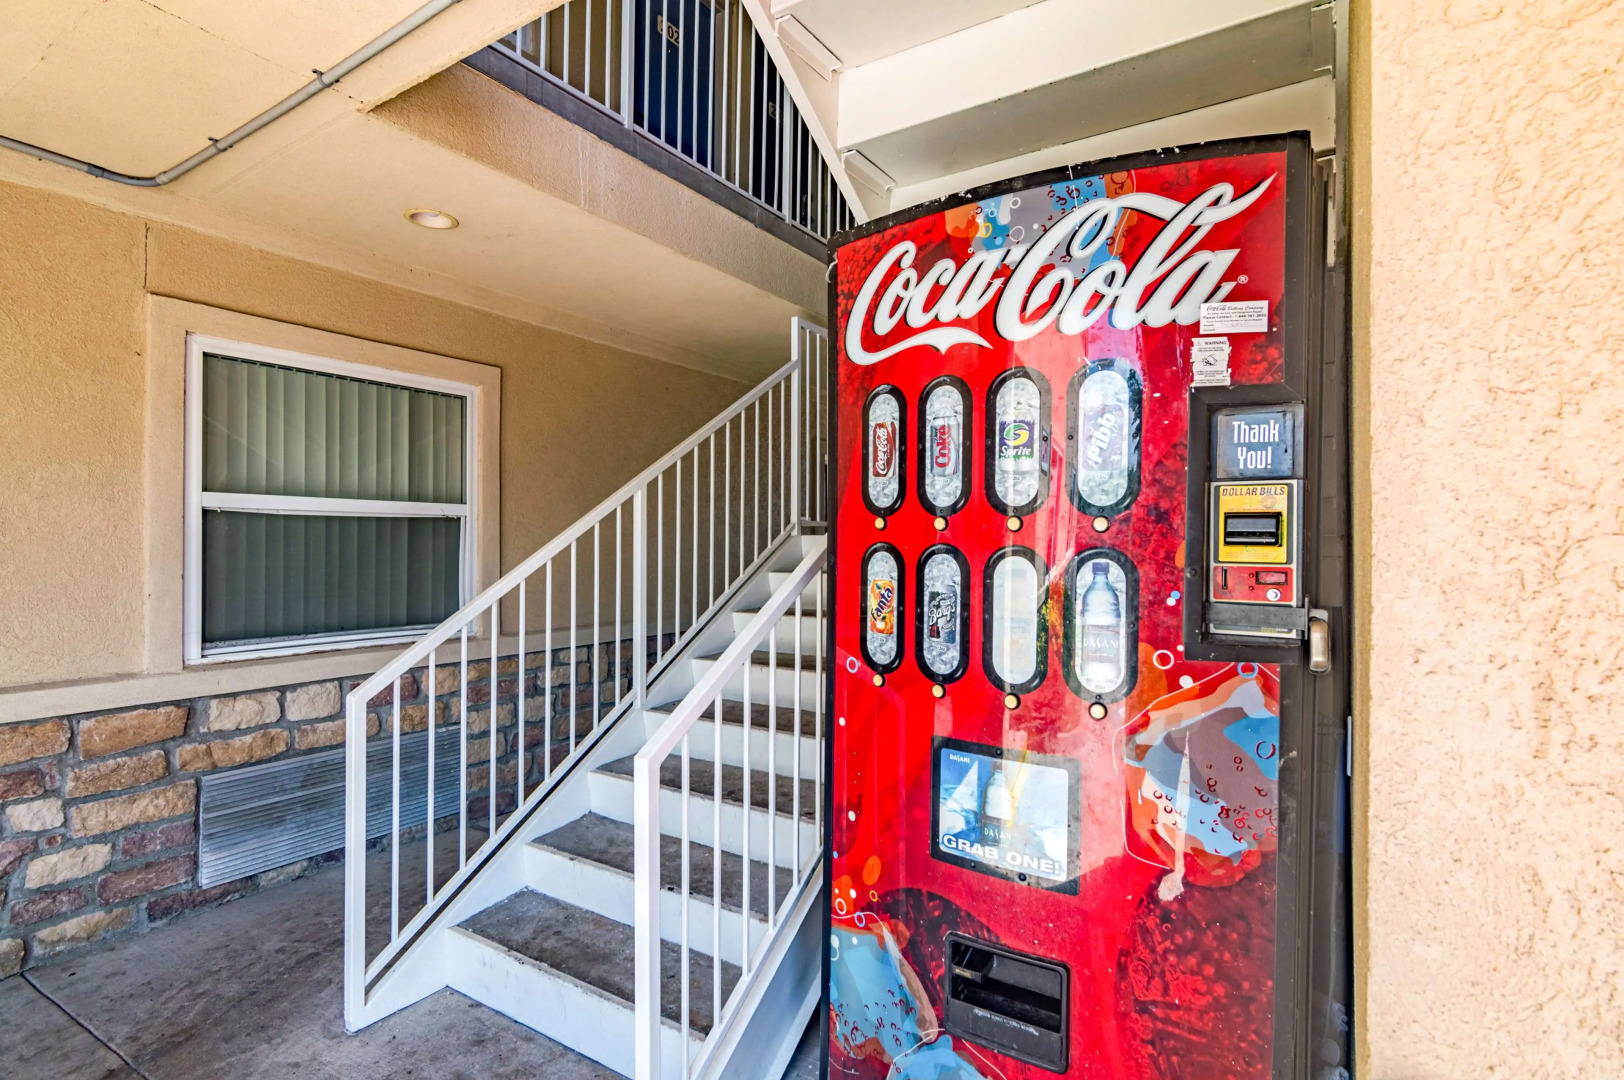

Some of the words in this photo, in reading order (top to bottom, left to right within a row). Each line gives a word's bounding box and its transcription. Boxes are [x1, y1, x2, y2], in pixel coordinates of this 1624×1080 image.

[1086, 412, 1116, 465] Pibb
[1232, 419, 1280, 443] Thank
[935, 424, 951, 468] Coke
[1000, 446, 1032, 458] Sprite
[1237, 446, 1272, 469] You!
[1222, 486, 1258, 497] DOLLAR
[1259, 486, 1285, 496] BILLS
[949, 754, 971, 764] DASANI
[942, 834, 999, 860] GRAB
[1005, 851, 1061, 875] ONE!
